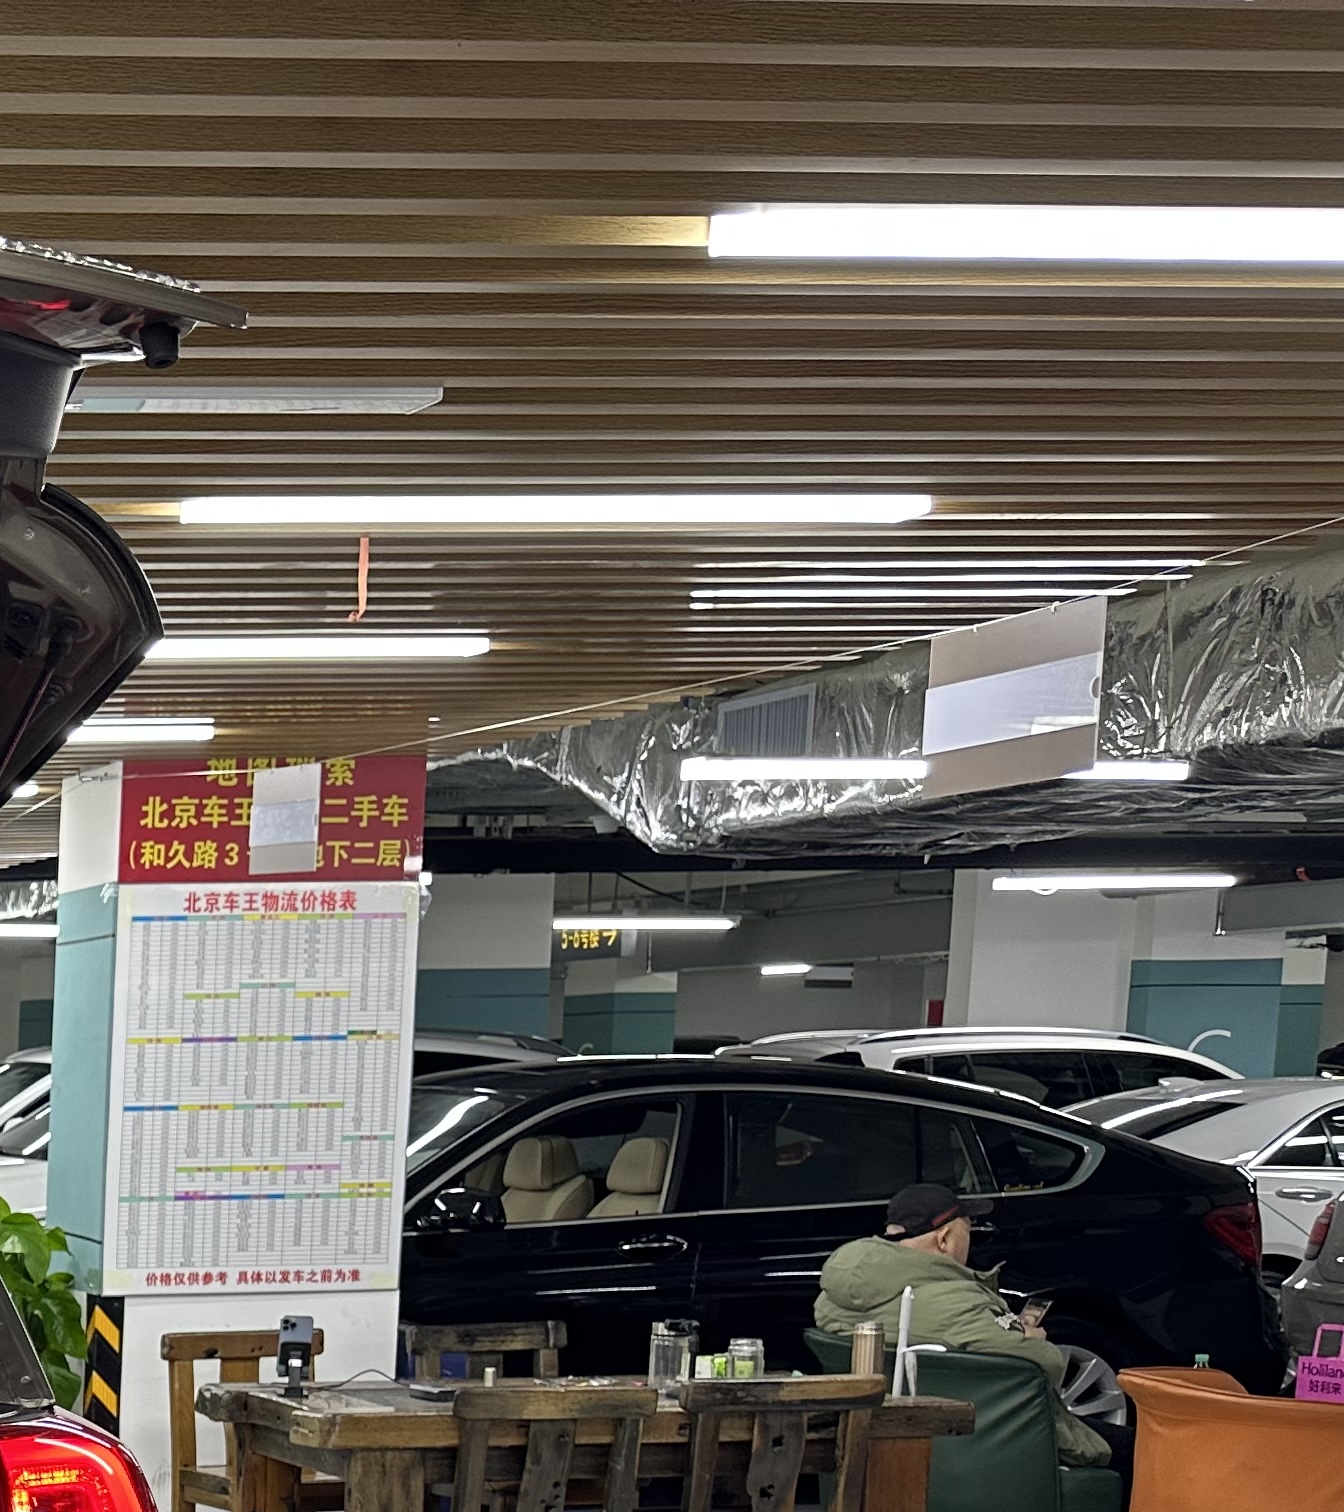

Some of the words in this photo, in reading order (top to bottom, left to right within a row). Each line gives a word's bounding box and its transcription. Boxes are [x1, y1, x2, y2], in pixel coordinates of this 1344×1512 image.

[139, 796, 410, 829] 北京车王二手车
[183, 890, 358, 914] 北京车王物流价格表
[145, 1271, 229, 1288] 价格仅供参考
[235, 1267, 362, 1286] 具体以发车之前为准
[1302, 1362, 1344, 1378] Holilan
[1309, 1380, 1341, 1395] 好利来
